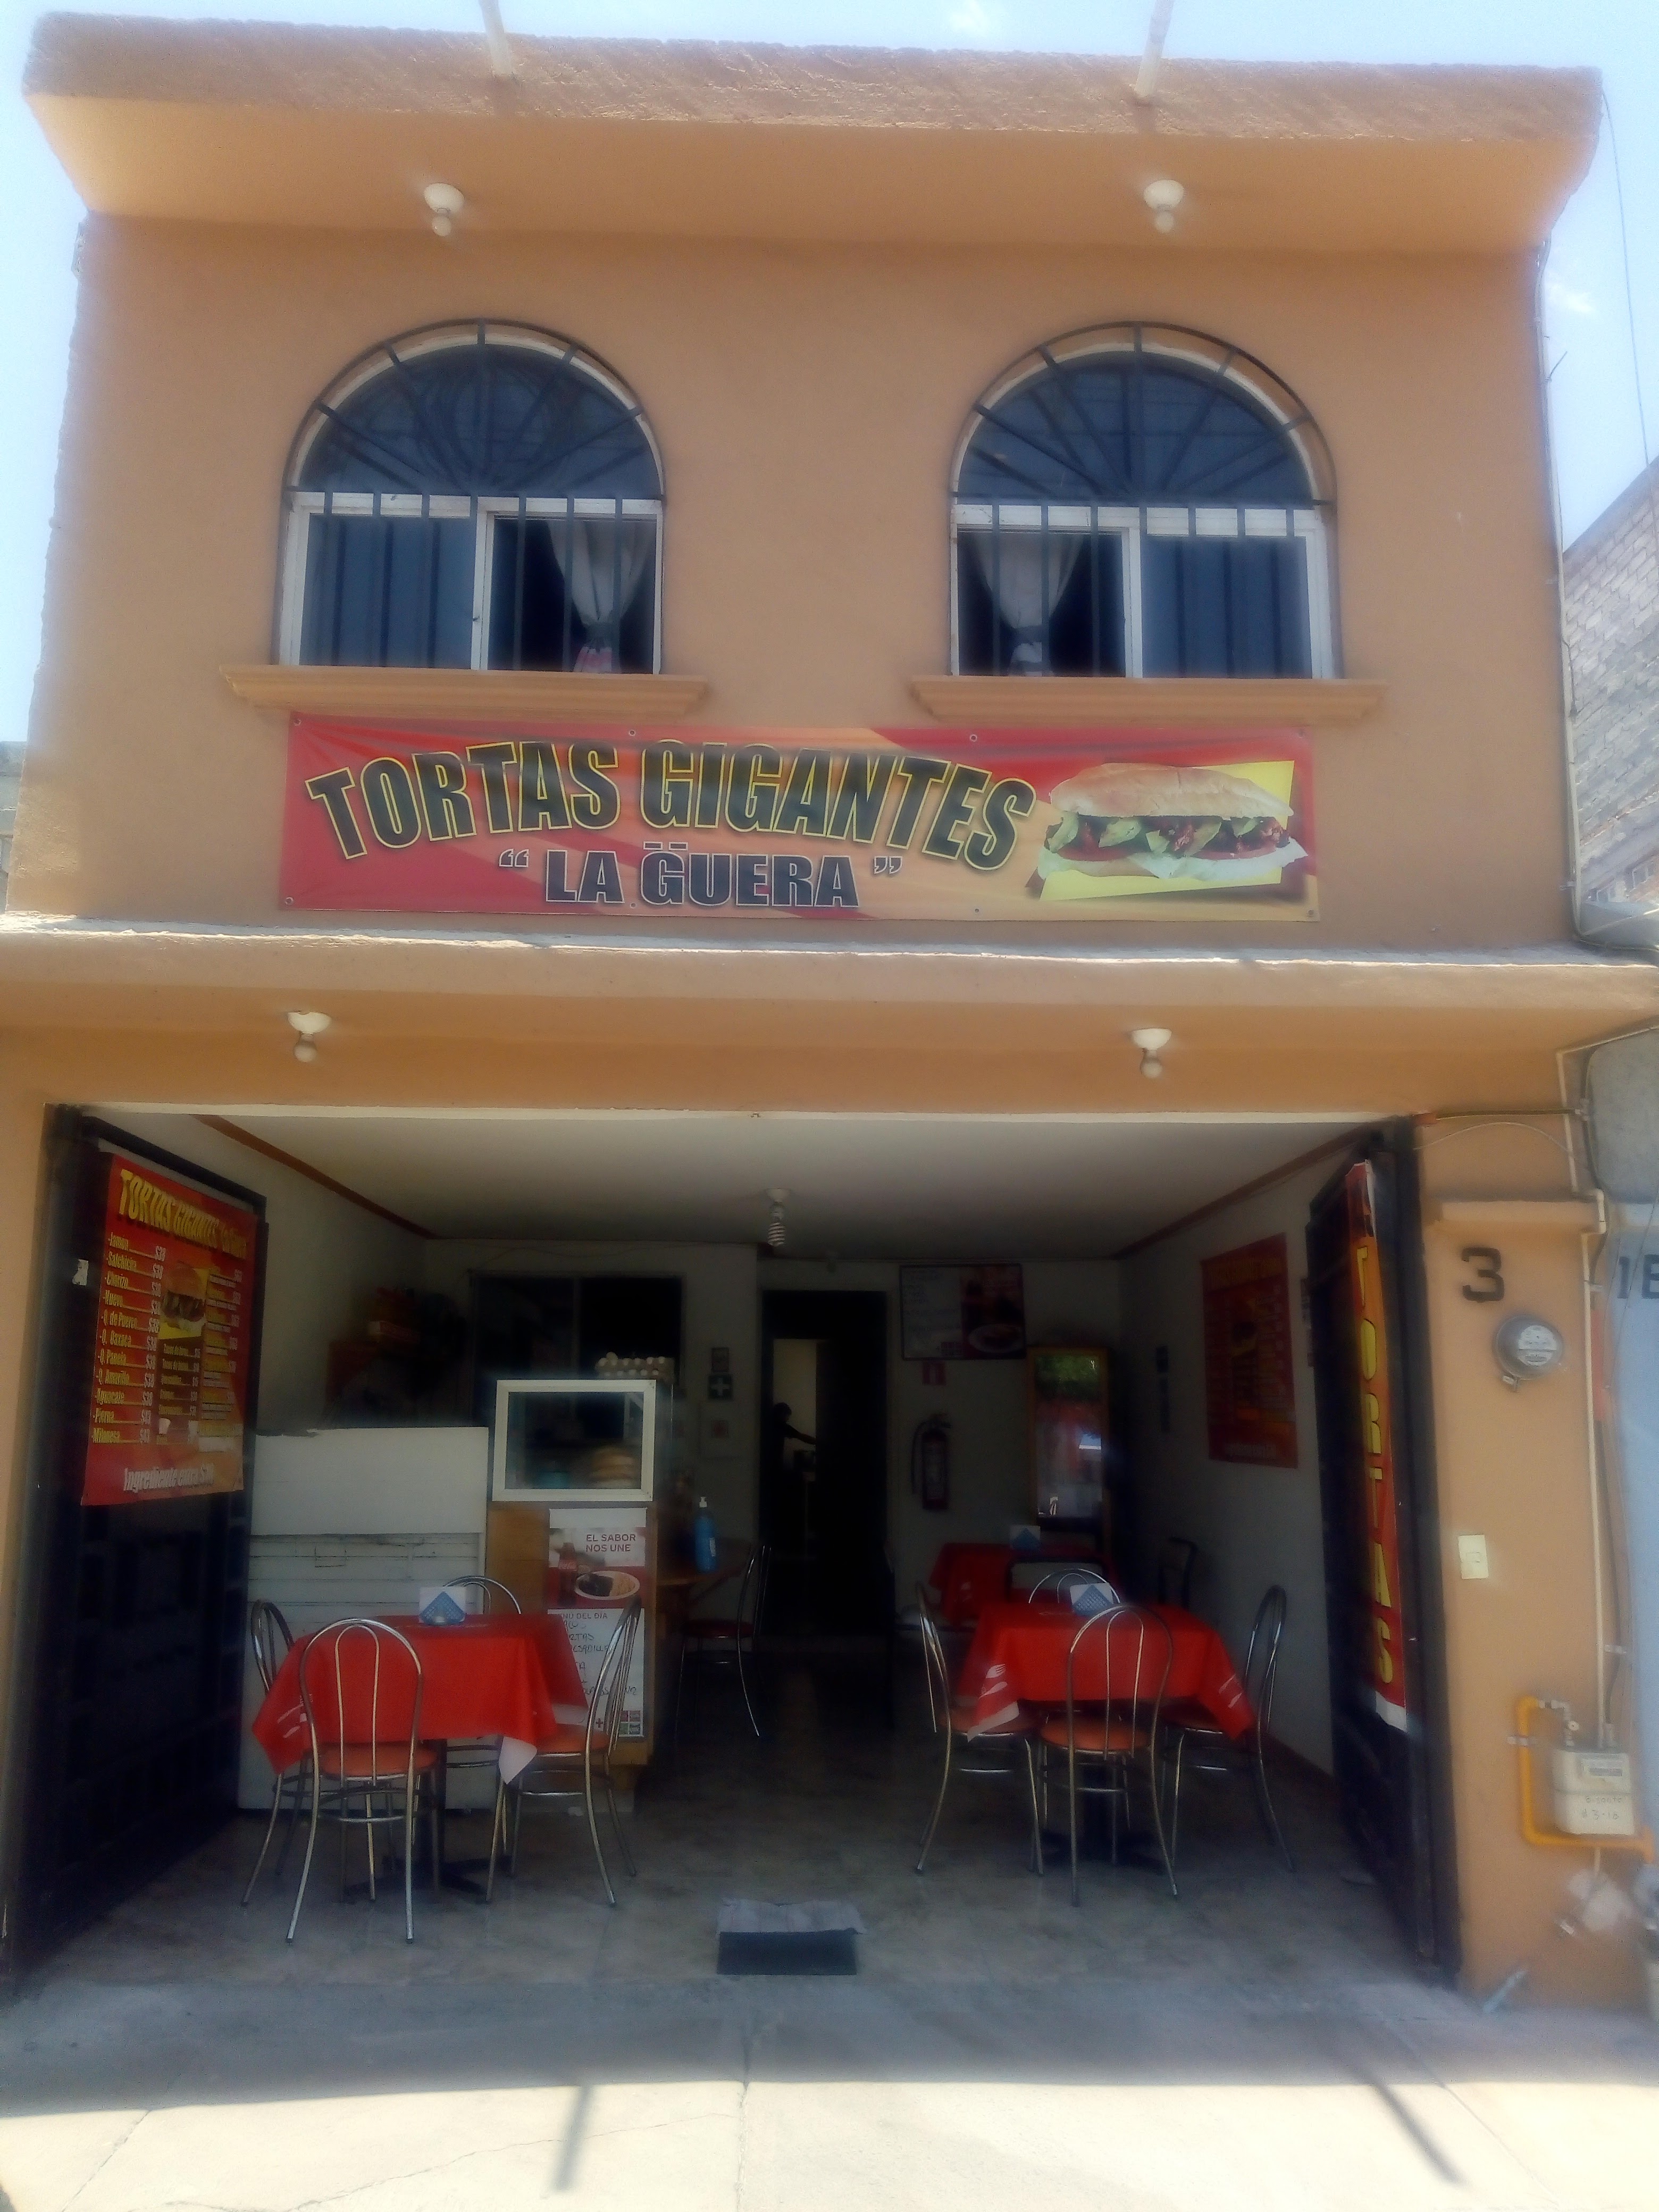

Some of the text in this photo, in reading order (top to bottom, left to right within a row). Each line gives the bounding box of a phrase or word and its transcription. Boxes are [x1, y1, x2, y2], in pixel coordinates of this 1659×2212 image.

[304, 739, 1037, 871] TORTAS GIGANTES
[546, 849, 625, 904] LA
[119, 1168, 175, 1233] TORTAS
[1460, 1246, 1505, 1303] 3
[1356, 1245, 1393, 1685] TORTAS
[586, 1544, 607, 1552] NOS
